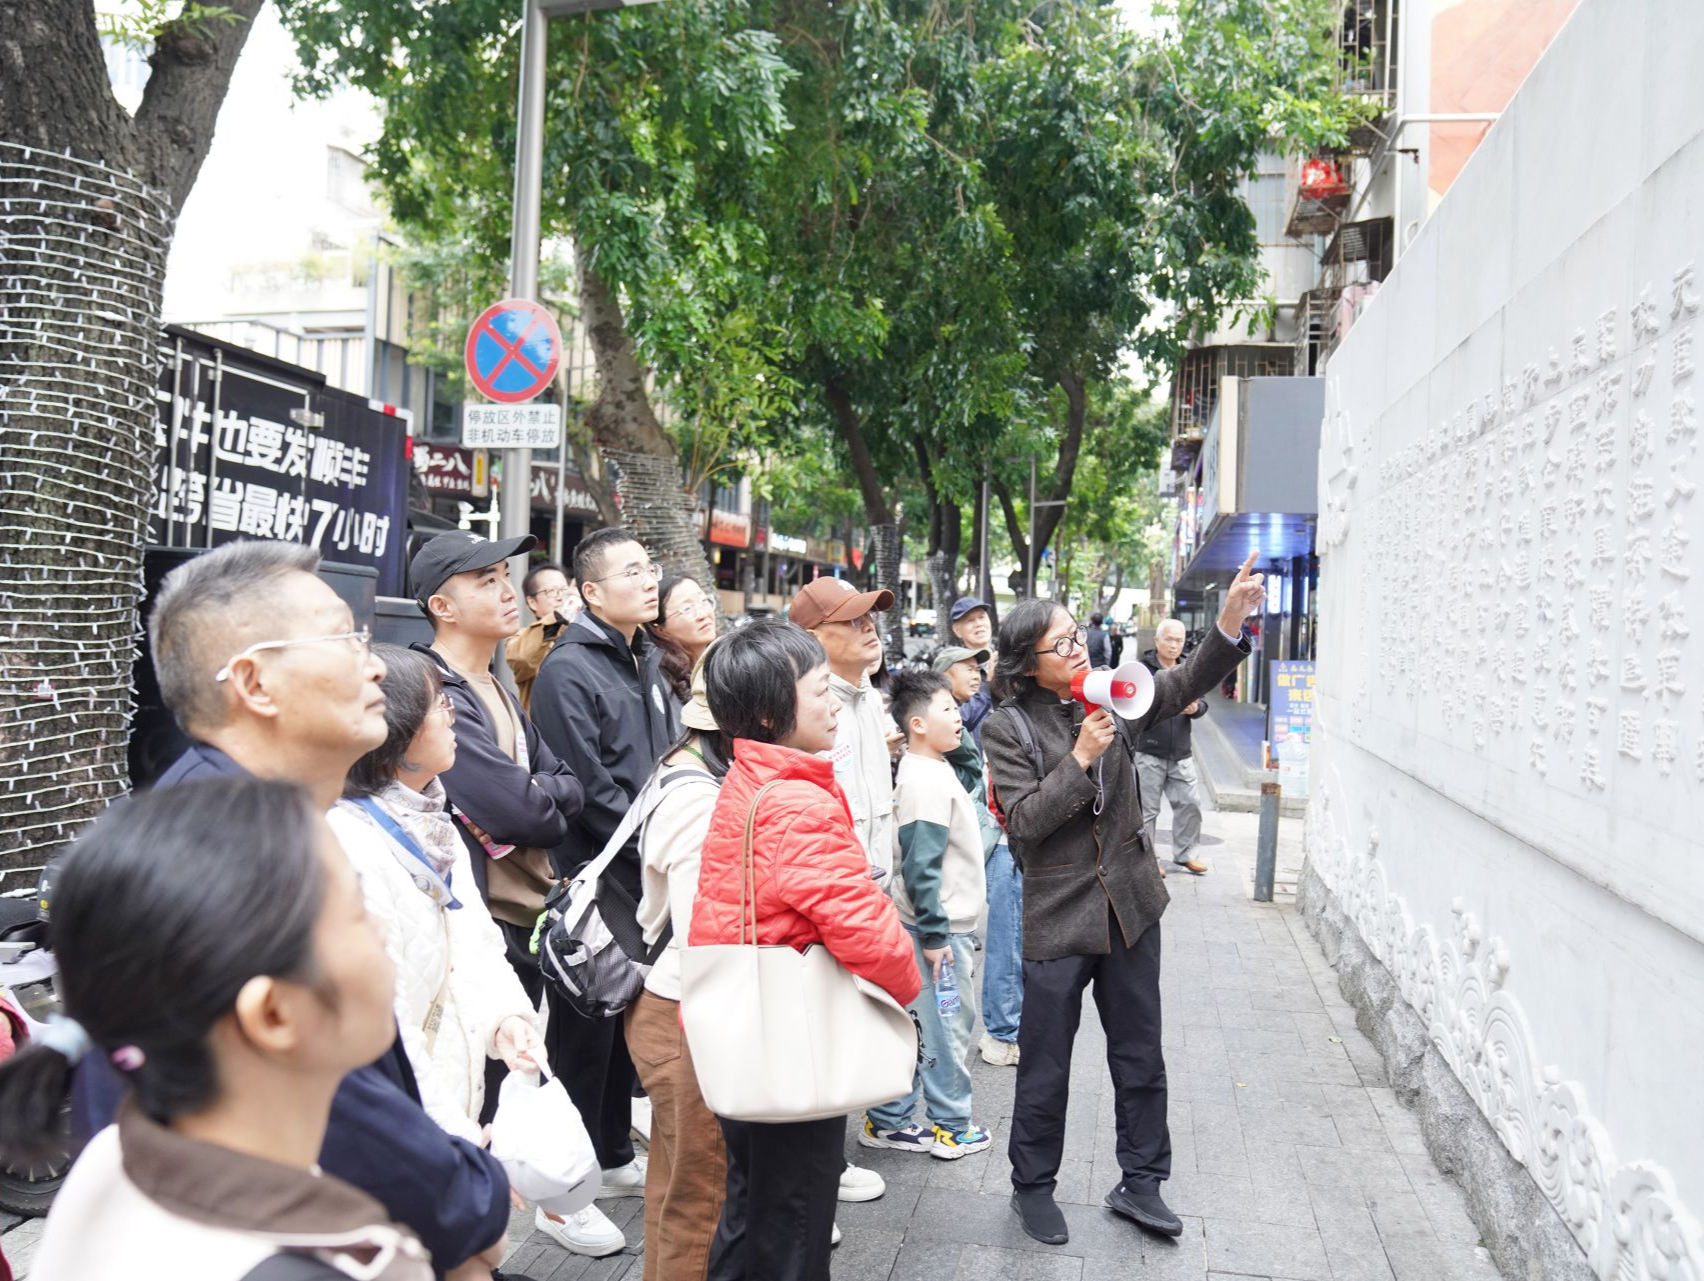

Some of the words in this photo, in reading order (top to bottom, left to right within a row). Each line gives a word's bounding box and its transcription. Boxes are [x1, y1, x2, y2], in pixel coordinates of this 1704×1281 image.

[468, 409, 557, 424] 停放区外禁止
[467, 428, 556, 443] 非机动车停放
